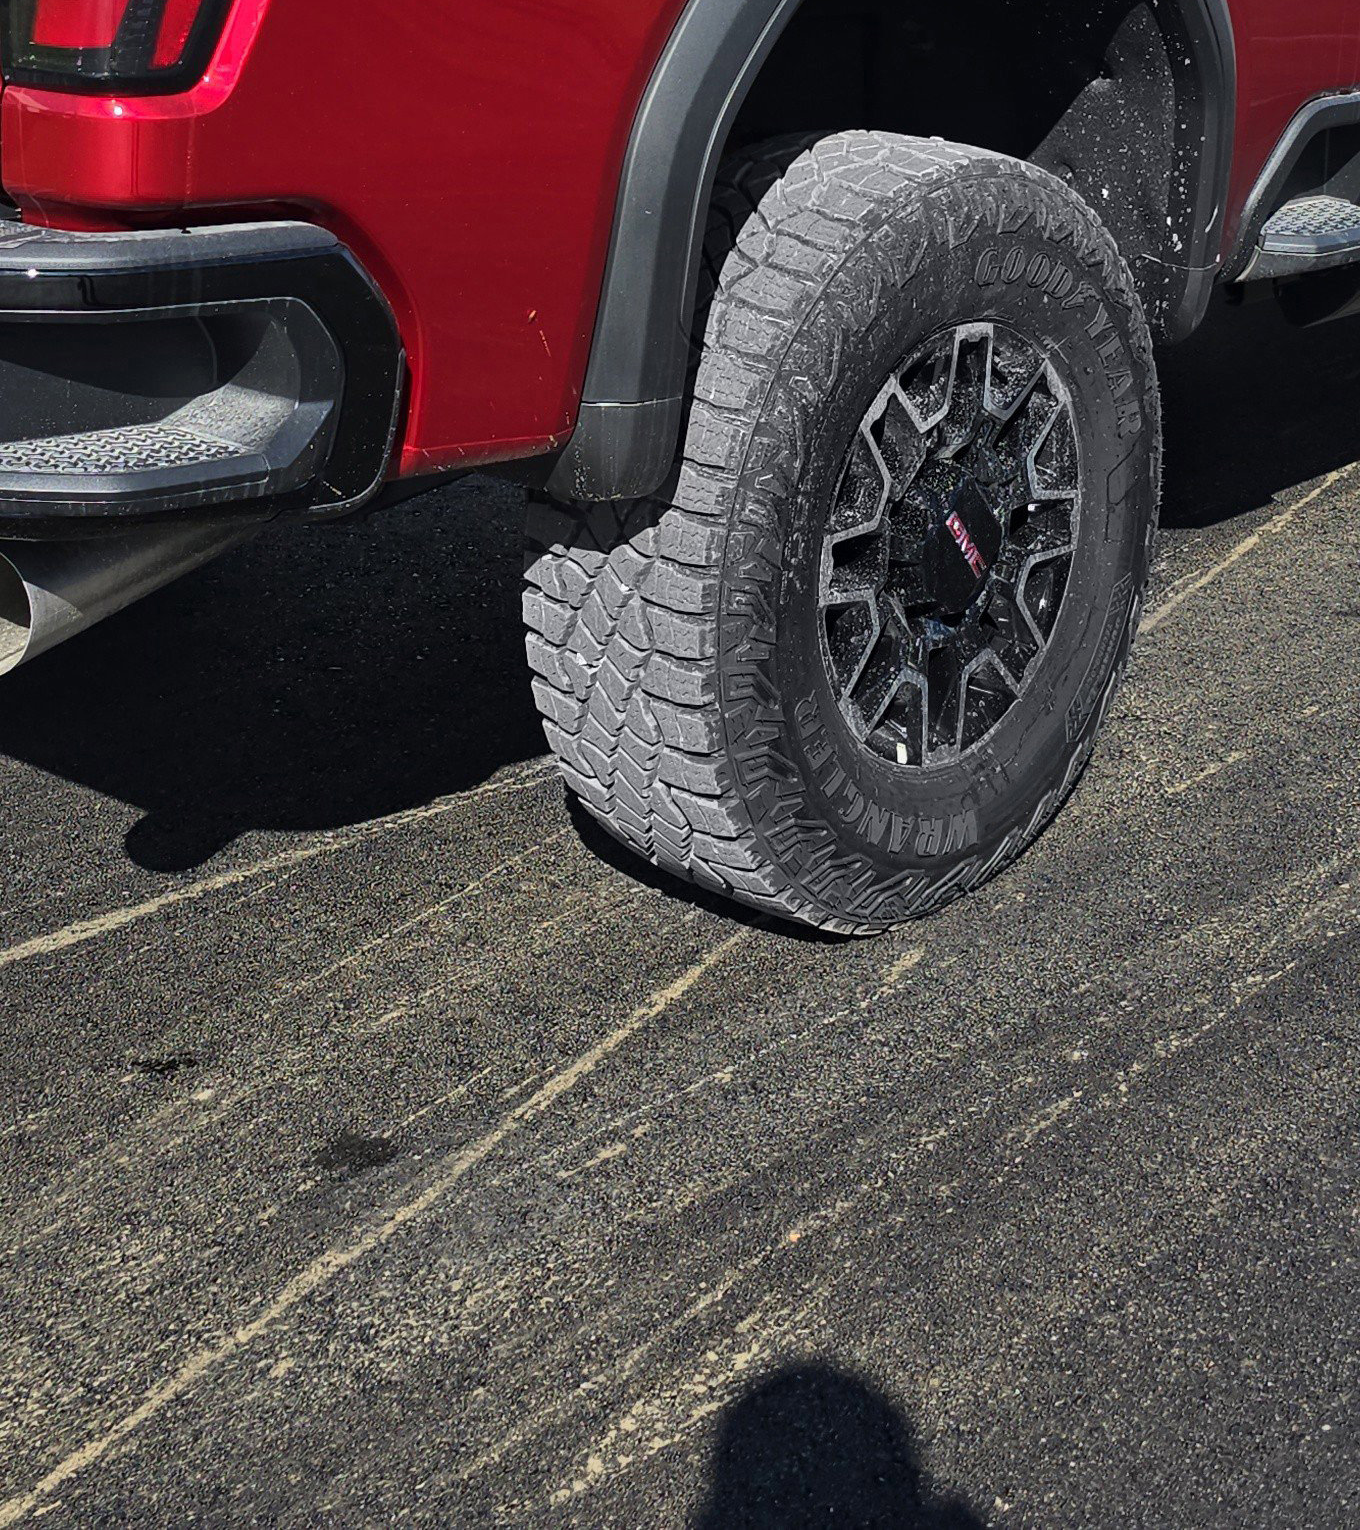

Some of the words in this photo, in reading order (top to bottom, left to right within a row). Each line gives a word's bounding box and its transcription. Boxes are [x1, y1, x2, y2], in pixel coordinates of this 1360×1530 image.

[974, 246, 1142, 439] GOODYEAR
[946, 511, 987, 579] GMC
[794, 689, 978, 857] WRANGLER
